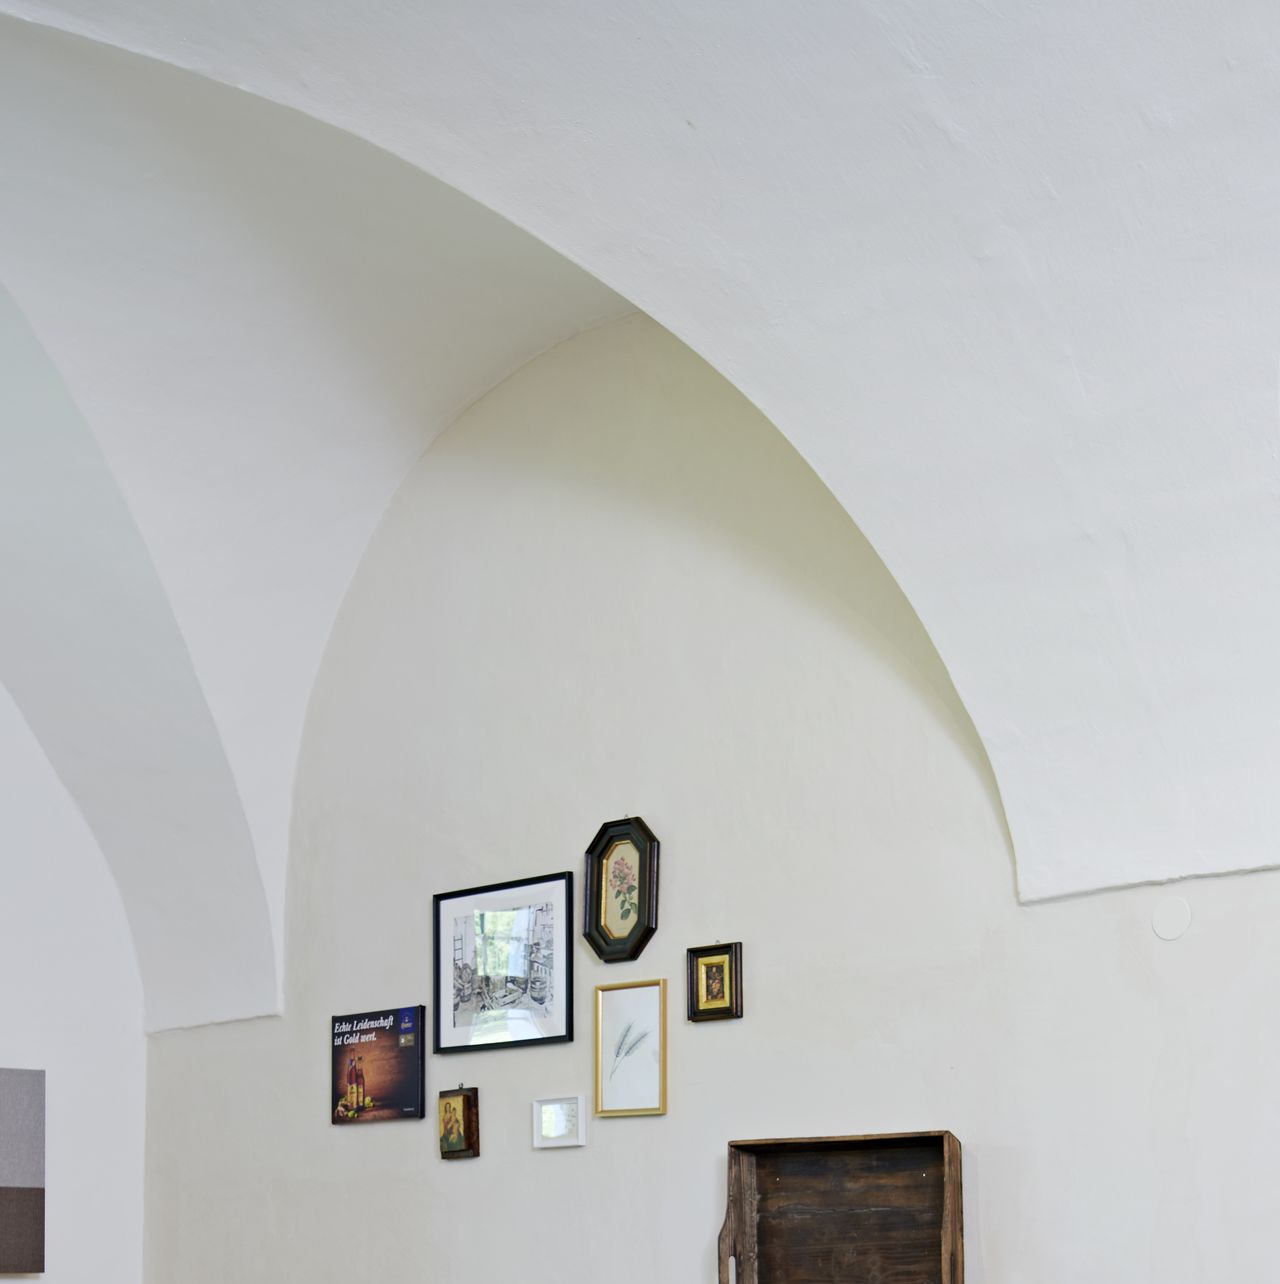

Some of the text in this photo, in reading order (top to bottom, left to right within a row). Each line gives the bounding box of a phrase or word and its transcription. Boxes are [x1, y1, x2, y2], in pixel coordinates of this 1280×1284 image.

[334, 1021, 352, 1033] Echte
[352, 1015, 394, 1031] Leidenschaft
[334, 1035, 342, 1046] ist
[343, 1032, 359, 1045] Gold
